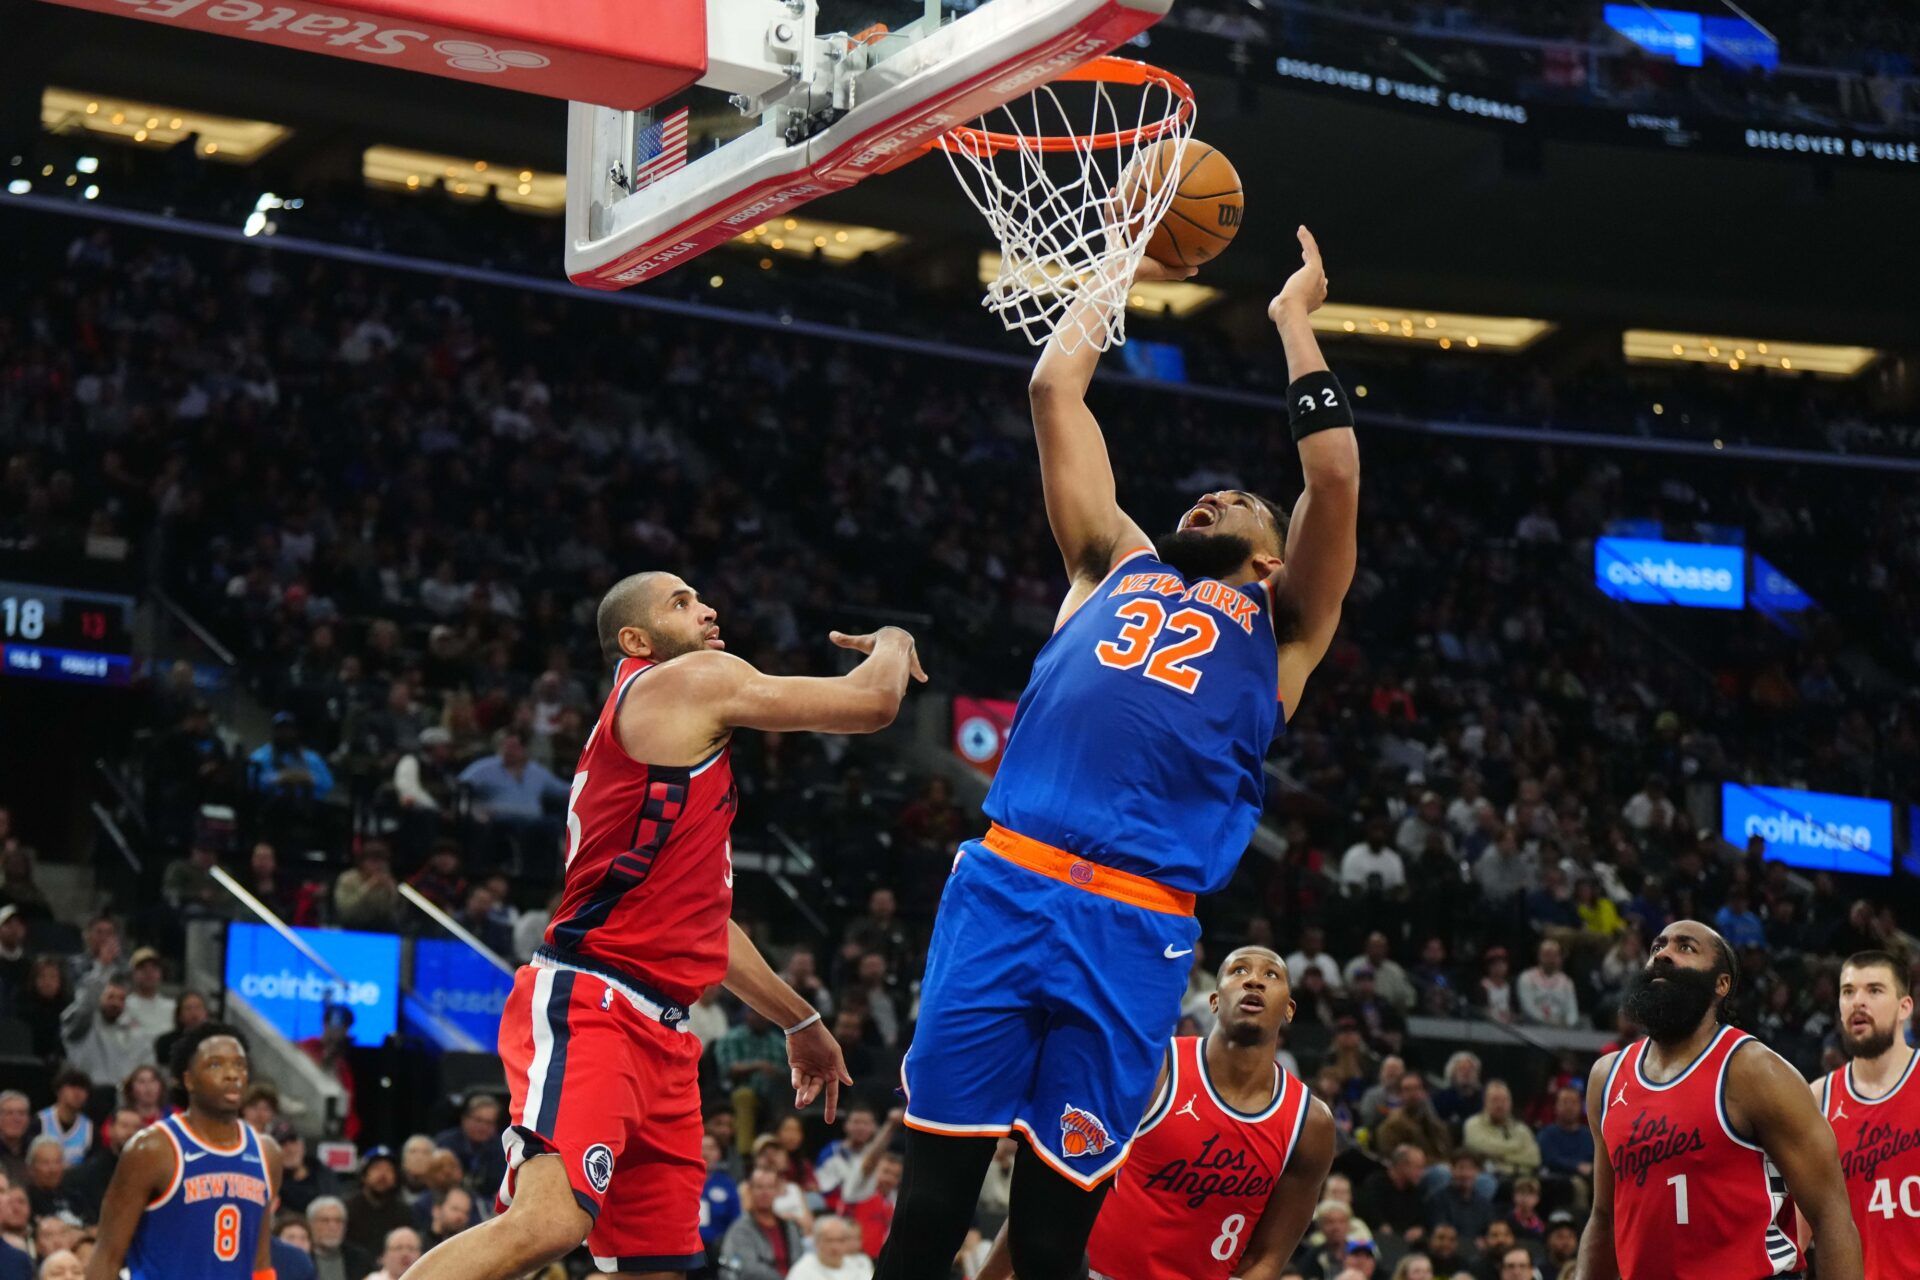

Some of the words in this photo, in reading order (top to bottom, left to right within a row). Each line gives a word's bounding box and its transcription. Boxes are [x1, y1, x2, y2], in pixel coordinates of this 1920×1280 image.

[989, 65, 1051, 95] HERDEZ
[1049, 36, 1106, 67] SALSA
[1276, 56, 1371, 91] DISCOVER
[850, 138, 904, 168] HERDEZ
[901, 112, 955, 139] SALSA
[1745, 128, 1845, 155] DISCOVER
[723, 200, 776, 226] HERDEZ
[769, 184, 819, 203] SALSA
[612, 261, 660, 282] HERDEZ
[654, 241, 699, 263] SALSA
[1298, 388, 1339, 415] 32
[1607, 556, 1733, 592] coinbase
[1, 597, 45, 640] 18
[1107, 573, 1186, 599] NEW
[1178, 580, 1260, 636] YORK
[1095, 597, 1220, 695] 32
[1745, 810, 1872, 852] coinbase
[240, 969, 380, 1006] coinbase
[1626, 1111, 1669, 1149] Los
[1856, 1121, 1893, 1151] Los
[1192, 1133, 1247, 1171] Los
[1614, 1125, 1705, 1187] Angeles
[183, 1174, 222, 1204] NEW
[222, 1172, 266, 1207] YORK
[1145, 1159, 1274, 1209] Angeles
[1667, 1173, 1689, 1225] 1
[1868, 1175, 1920, 1219] 40
[213, 1204, 241, 1261] 8
[1210, 1213, 1245, 1261] 8
